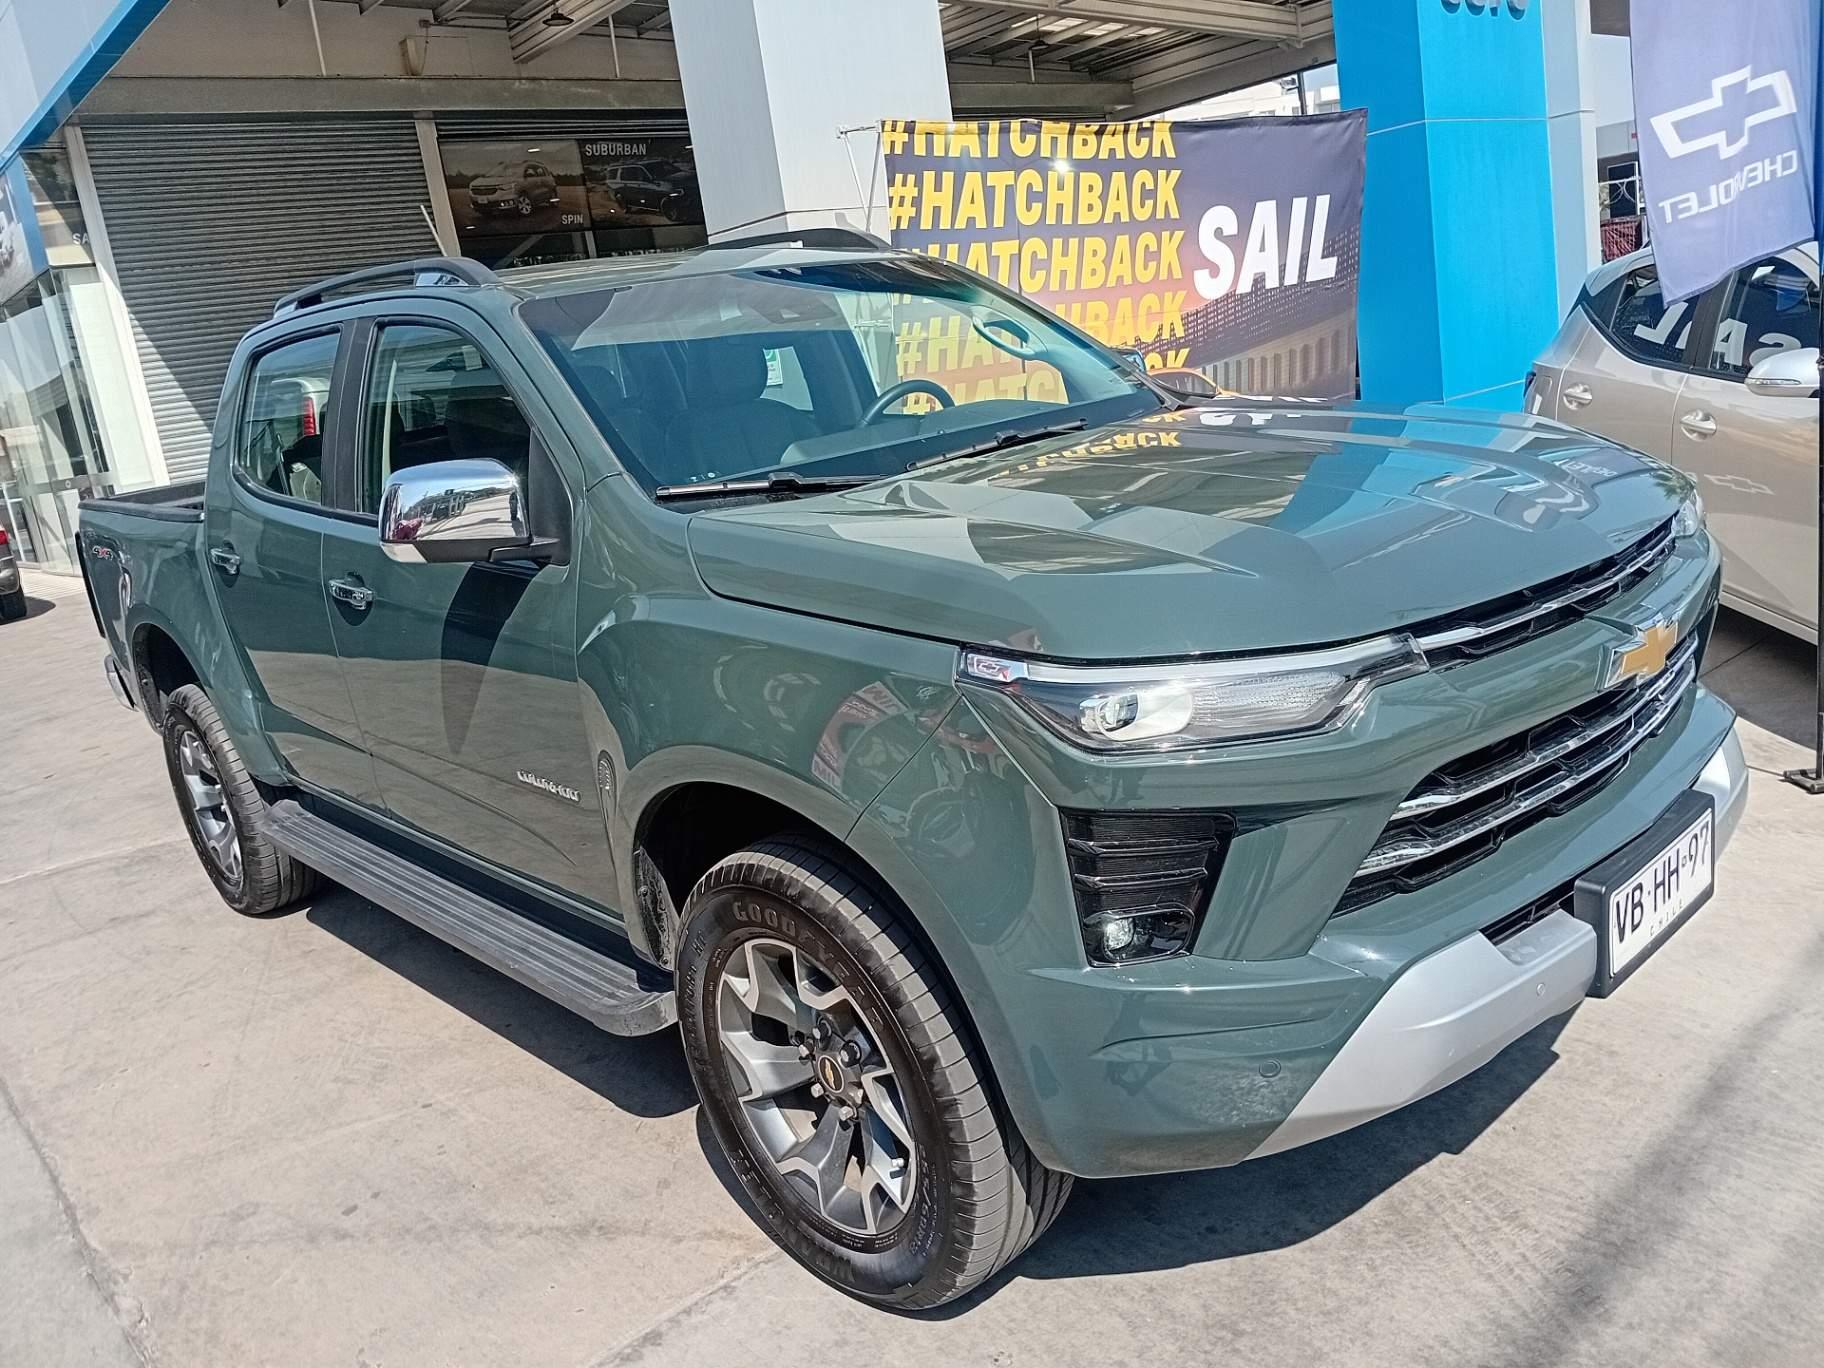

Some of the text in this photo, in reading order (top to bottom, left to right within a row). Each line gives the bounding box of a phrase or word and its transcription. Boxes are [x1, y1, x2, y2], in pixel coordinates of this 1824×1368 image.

[585, 143, 647, 157] SUBURBAN
[561, 213, 584, 225] SPIN
[889, 169, 1183, 231] #HATCHBACK
[1193, 194, 1338, 301] SAIL
